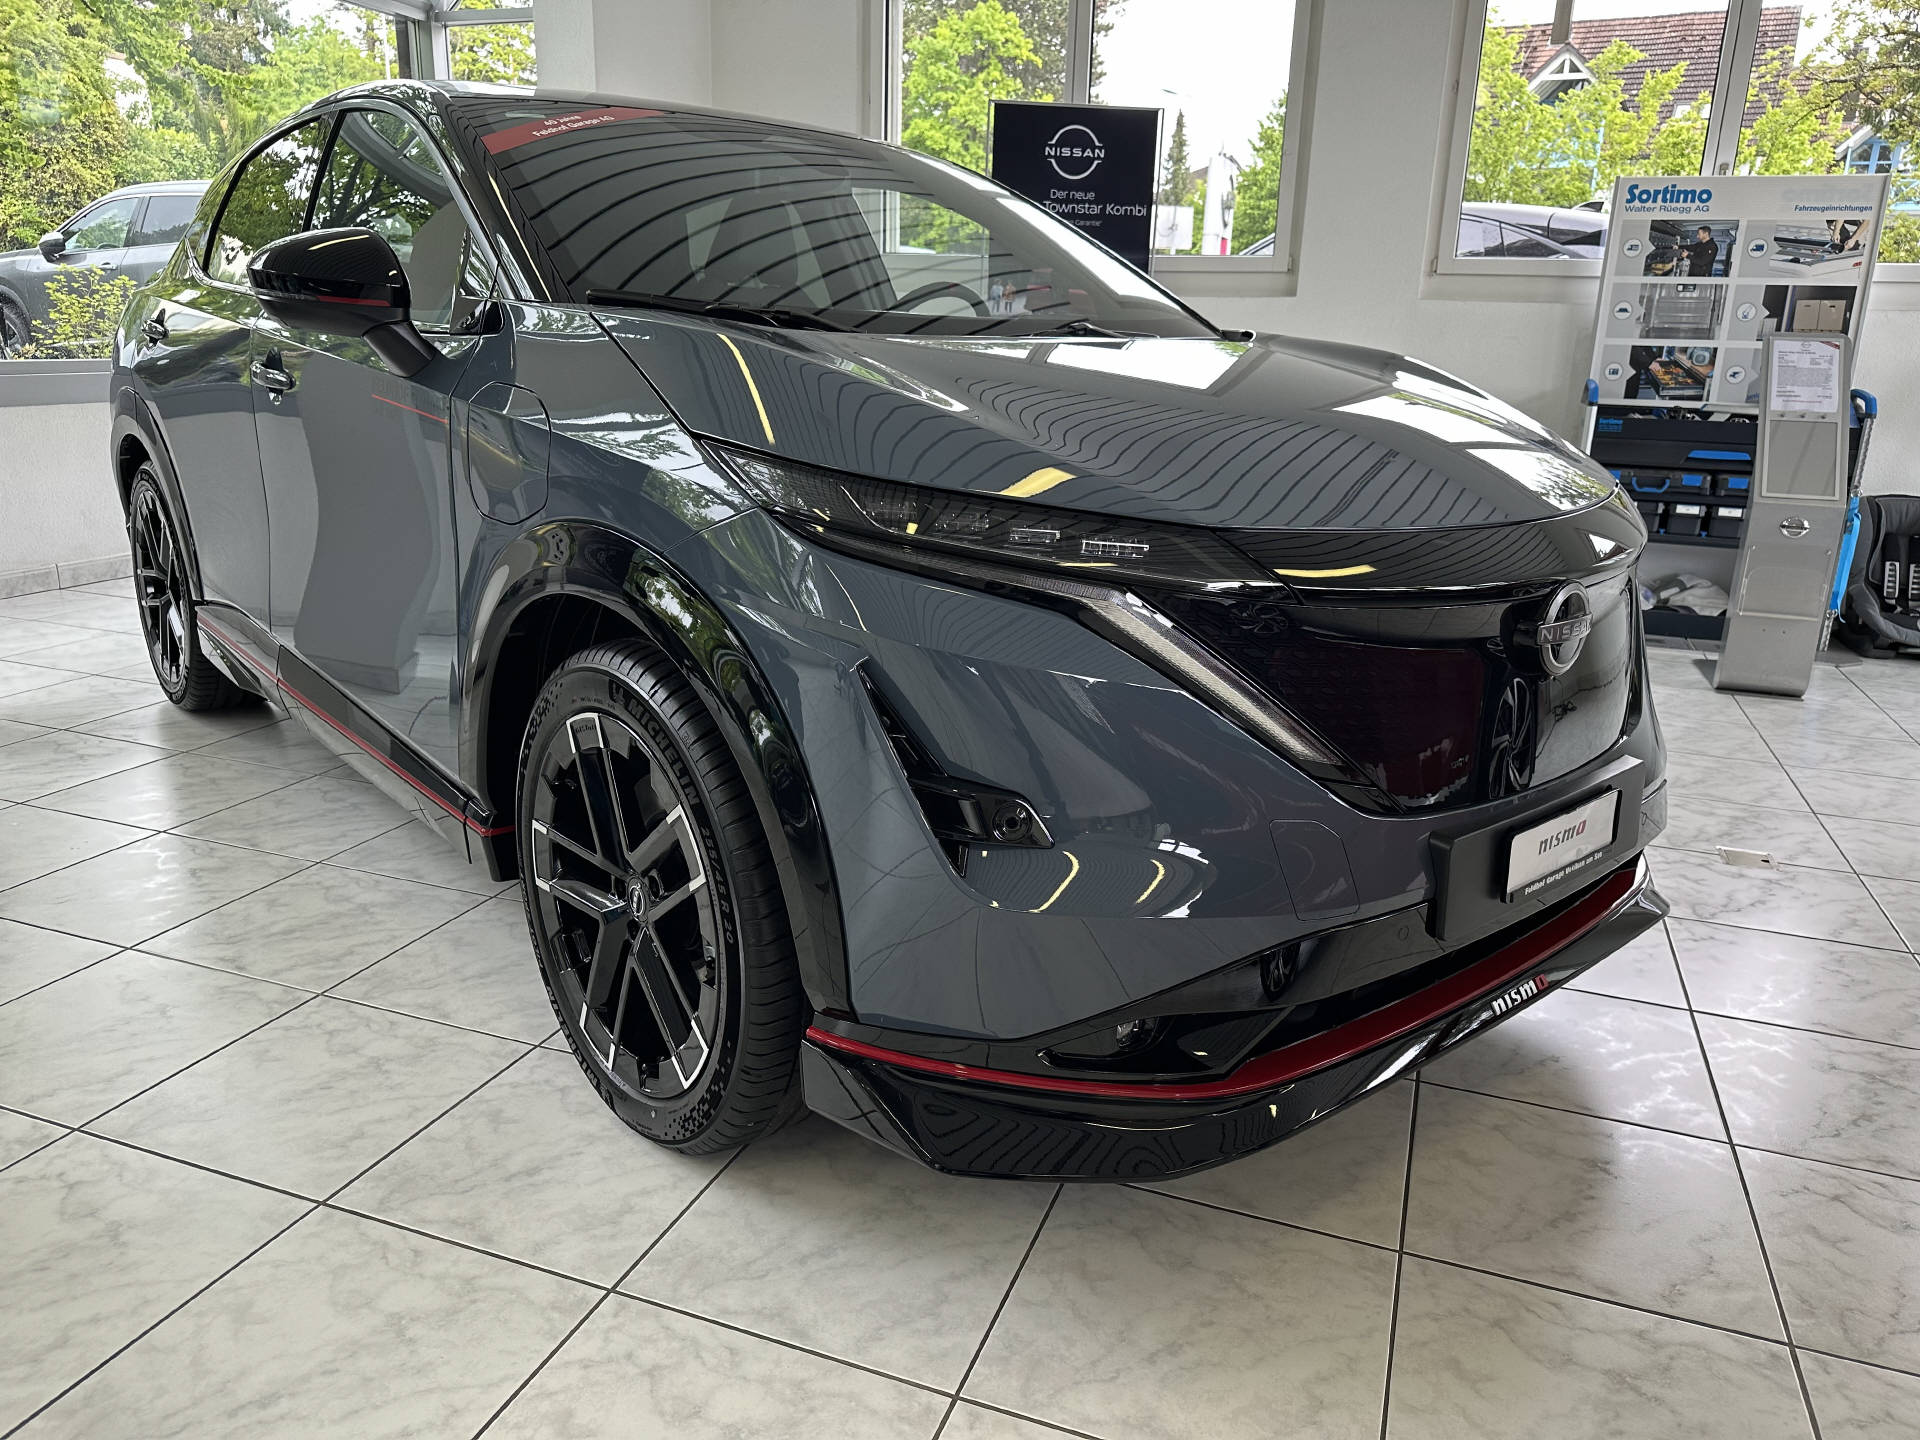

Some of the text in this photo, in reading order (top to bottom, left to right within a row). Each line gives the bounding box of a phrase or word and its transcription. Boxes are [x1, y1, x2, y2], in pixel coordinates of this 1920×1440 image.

[567, 119, 600, 128] Garage
[1044, 146, 1105, 158] NISSAN
[1050, 189, 1096, 200] Der neue
[1625, 183, 1713, 204] Sortimo
[1042, 200, 1148, 217] Townstar Kombi
[1624, 204, 1710, 215] Walter Rüegg AG
[1794, 204, 1873, 213] Fahrzeugeinrichtungen
[1540, 619, 1591, 642] NISSAN
[627, 698, 701, 806] MICHELIN
[1538, 819, 1587, 855] nismo
[700, 826, 735, 945] 255/45 R 20
[1491, 974, 1549, 1016] nismo
